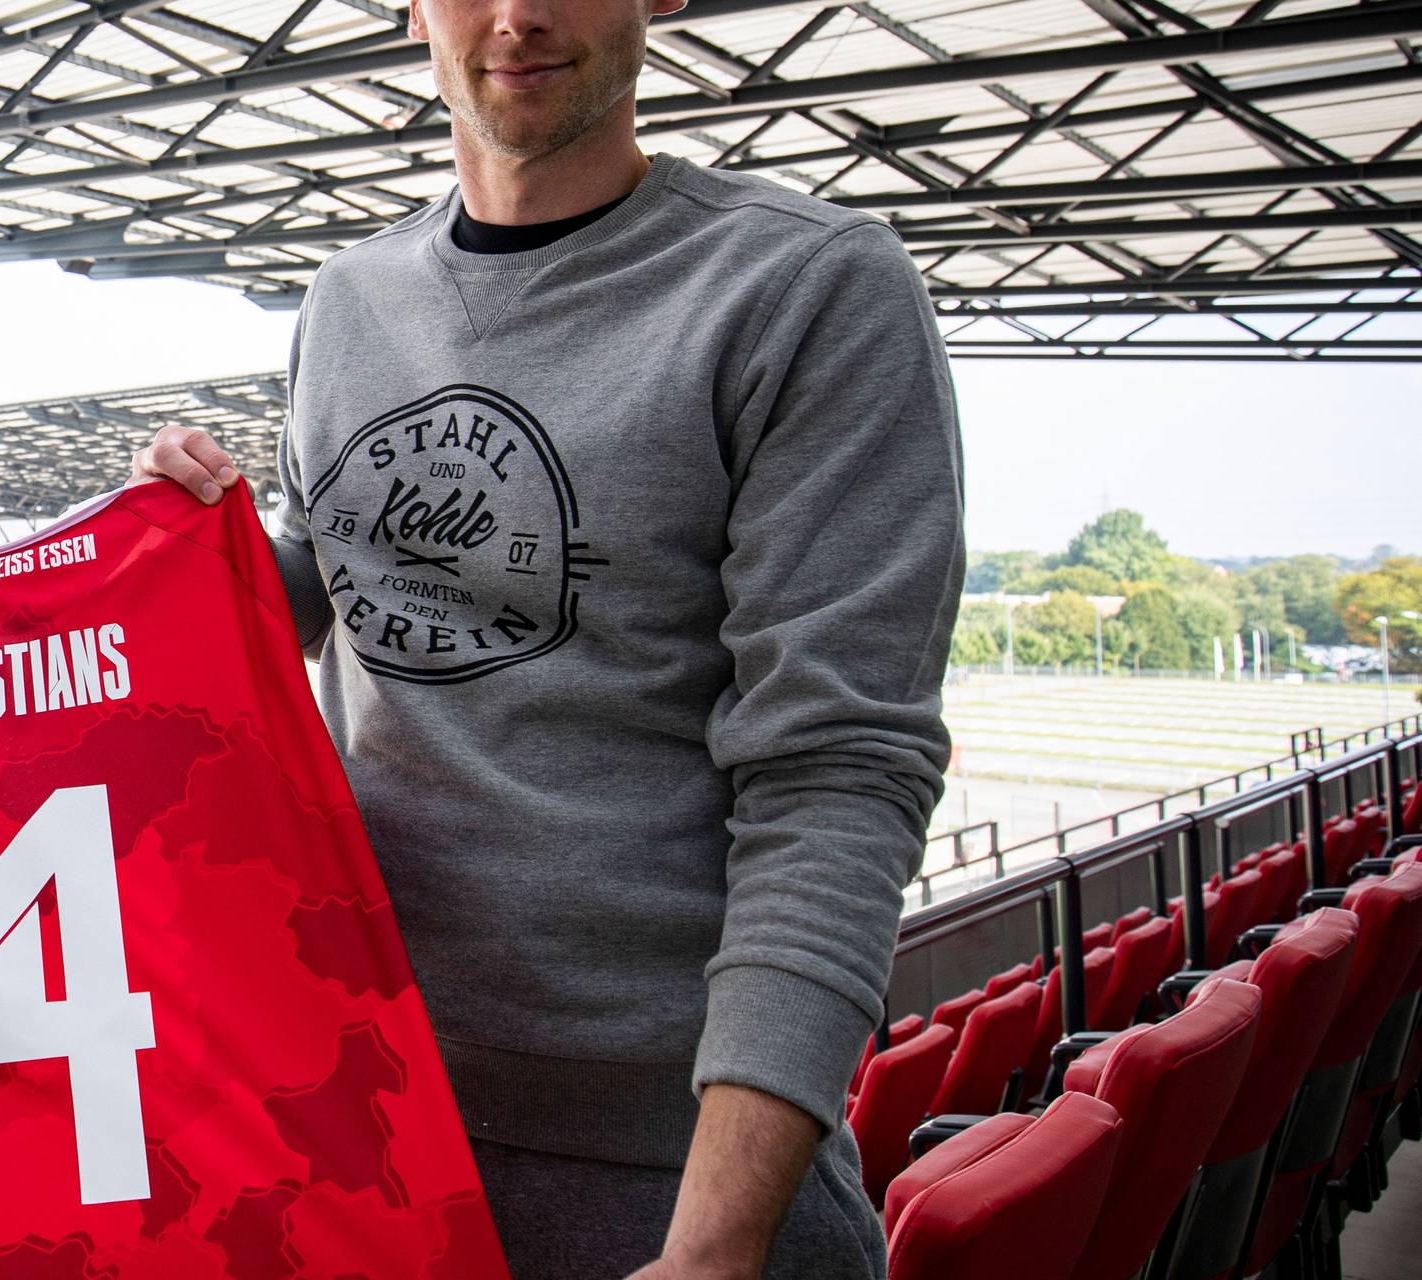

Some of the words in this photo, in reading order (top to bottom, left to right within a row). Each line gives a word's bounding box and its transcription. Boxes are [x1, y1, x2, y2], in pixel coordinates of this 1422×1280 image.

[369, 413, 517, 483] STAHL
[429, 462, 466, 479] UND
[327, 515, 356, 537] 19
[368, 476, 499, 550] Kohle
[39, 533, 97, 571] ESSEN
[508, 541, 538, 566] 07
[378, 574, 475, 605] FORMTEN
[329, 563, 539, 654] VEREIN
[401, 601, 449, 622] DEN
